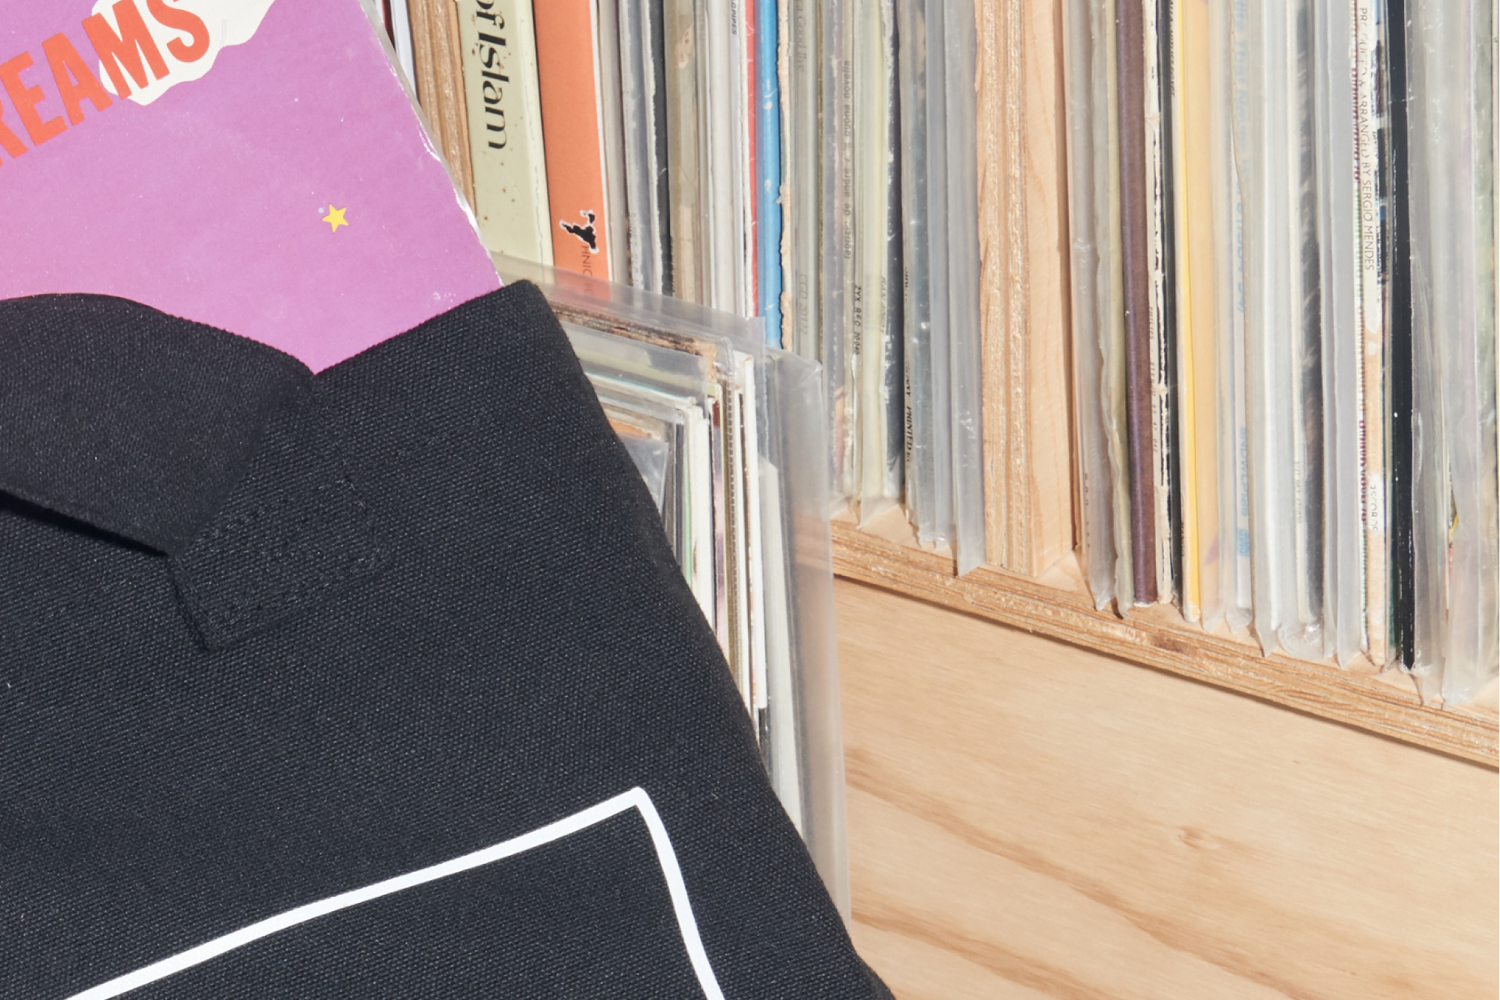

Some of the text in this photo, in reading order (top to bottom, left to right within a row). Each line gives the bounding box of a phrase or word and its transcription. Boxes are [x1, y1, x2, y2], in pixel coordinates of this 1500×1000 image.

[730, 0, 738, 35] GPIPES
[478, 31, 510, 150] Islam
[842, 60, 851, 99] novella
[1359, 93, 1370, 158] ARRANGED
[1361, 162, 1372, 176] BY
[843, 202, 851, 216] de
[1362, 180, 1374, 222] SERGIO
[1364, 225, 1375, 271] MENDES
